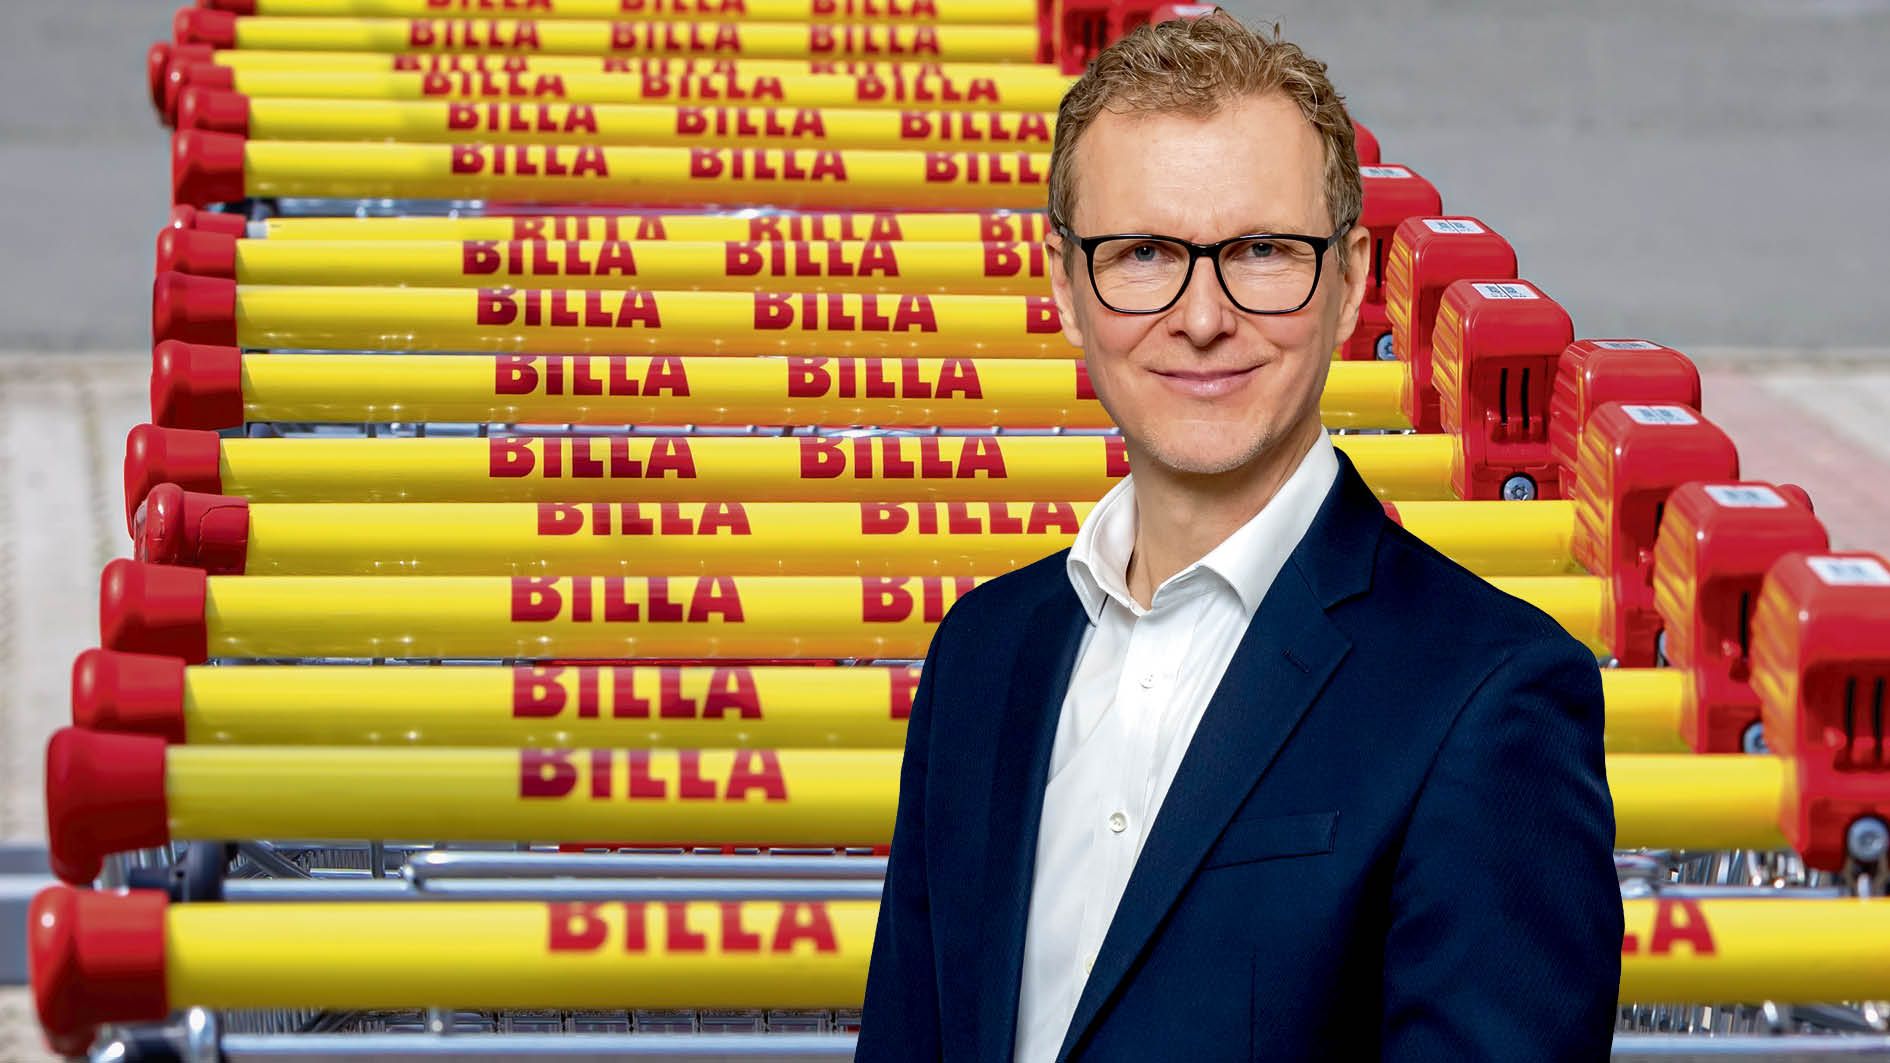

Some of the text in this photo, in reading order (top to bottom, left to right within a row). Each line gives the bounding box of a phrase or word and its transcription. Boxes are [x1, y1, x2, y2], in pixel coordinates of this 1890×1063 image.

[409, 21, 941, 55] BILLA BILLA BILLA
[447, 103, 1050, 142] BILLA BILLA BILLA
[451, 145, 609, 177] BILLA
[690, 149, 848, 181] BILLA
[462, 240, 900, 277] BILLA BILLA
[476, 289, 938, 332] BILLA BILLA
[496, 355, 984, 399] BILLA BILLA
[489, 437, 1008, 478] BILLA BILLA
[537, 503, 1080, 535] BILLA BILLA
[510, 577, 745, 623] BILLA
[512, 667, 763, 719] BILLA
[519, 750, 789, 801] BILLA
[547, 902, 839, 953] BILLA
